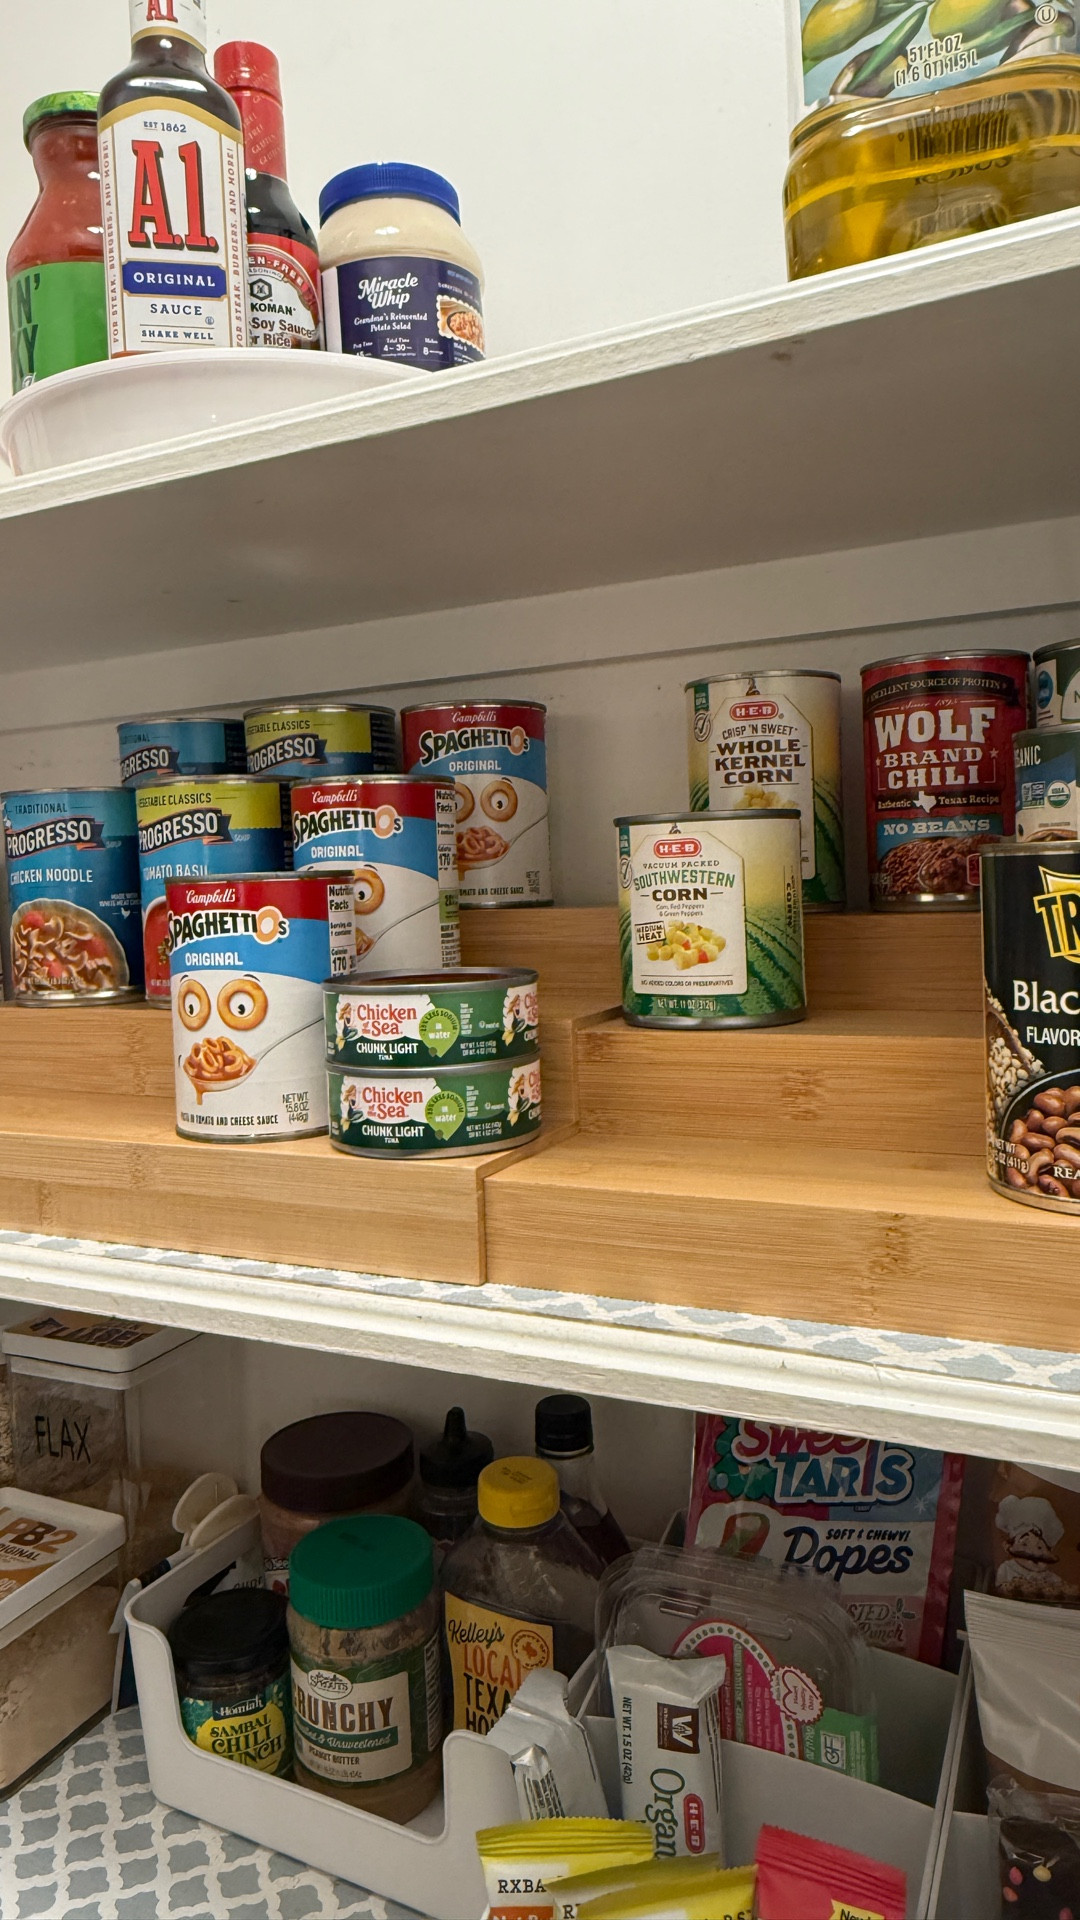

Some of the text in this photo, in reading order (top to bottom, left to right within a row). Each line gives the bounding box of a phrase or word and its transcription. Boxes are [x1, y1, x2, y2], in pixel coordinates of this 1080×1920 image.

[909, 34, 963, 63] 51 FL OZ
[970, 52, 979, 66] L
[143, 120, 188, 134] EST 1862
[227, 147, 235, 186] MORE!
[228, 190, 237, 215] AND
[102, 140, 120, 344] FOR STEAK, BURGERS, AND MORE!
[230, 219, 240, 277] BURGERS,
[133, 271, 216, 287] ORIGINAL
[357, 271, 419, 300] Miracle
[233, 281, 242, 322] STEAK,
[367, 288, 410, 310] Whip
[150, 303, 203, 316] SAUCE
[389, 312, 428, 322] Reinvented
[141, 329, 214, 341] SHAKE WELL
[252, 317, 313, 338] Soy Sauce
[370, 321, 412, 333] Potato Salad
[263, 332, 291, 347] Rice
[910, 677, 948, 690] SOURCE
[947, 677, 960, 686] OF
[451, 711, 497, 723] Campbell's
[272, 719, 311, 732] CLASSICS
[722, 724, 747, 740] CRISP
[760, 724, 793, 736] SWEET
[874, 706, 996, 753] WOLF
[716, 739, 801, 756] WHOLE
[715, 753, 806, 772] KERNEL
[884, 746, 983, 768] BRAND
[449, 760, 501, 772] ORIGINAL
[723, 769, 793, 785] CORN
[887, 765, 980, 790] CHILI
[168, 792, 213, 805] CLASSICS
[312, 788, 358, 803] Campbell's
[938, 795, 967, 805] Texas
[969, 794, 1000, 805] Recipe
[15, 802, 68, 814] TRADITIONAL
[883, 819, 991, 836] NO BEANS
[7, 820, 92, 857] PROGRESSO
[311, 845, 364, 858] ORIGINAL
[643, 859, 720, 869] VACUUM PACKED
[46, 868, 94, 883] NOODLE
[634, 869, 736, 892] SOUTHWESTERN
[186, 887, 236, 905] Campbell's
[651, 887, 708, 902] CORN
[329, 899, 349, 911] Facts
[638, 932, 663, 942] HEAT
[185, 951, 244, 967] ORIGINAL
[332, 956, 347, 972] 170
[1012, 979, 1080, 1016] Blac
[356, 1003, 418, 1024] Chicken
[371, 1021, 400, 1037] Sea
[428, 1031, 451, 1040] water
[356, 1042, 419, 1054] CHUNK LIGHT
[362, 1087, 424, 1106] Chicken
[230, 1115, 255, 1126] CHEESE
[256, 1114, 279, 1125] SAUCE
[376, 1104, 407, 1120] Sea
[435, 1114, 457, 1123] water
[362, 1125, 425, 1137] CHUNK LIGHT
[35, 1415, 91, 1464] FLAX
[0, 1517, 78, 1554] PB2
[825, 1528, 853, 1540] SOFT
[448, 1619, 505, 1649] Kelley's
[210, 1713, 272, 1738] SAMBAL
[211, 1724, 272, 1755] CHILI
[621, 1697, 633, 1785] NET WT. 1.5 OZ (42g)
[332, 1754, 361, 1766] BUTTER
